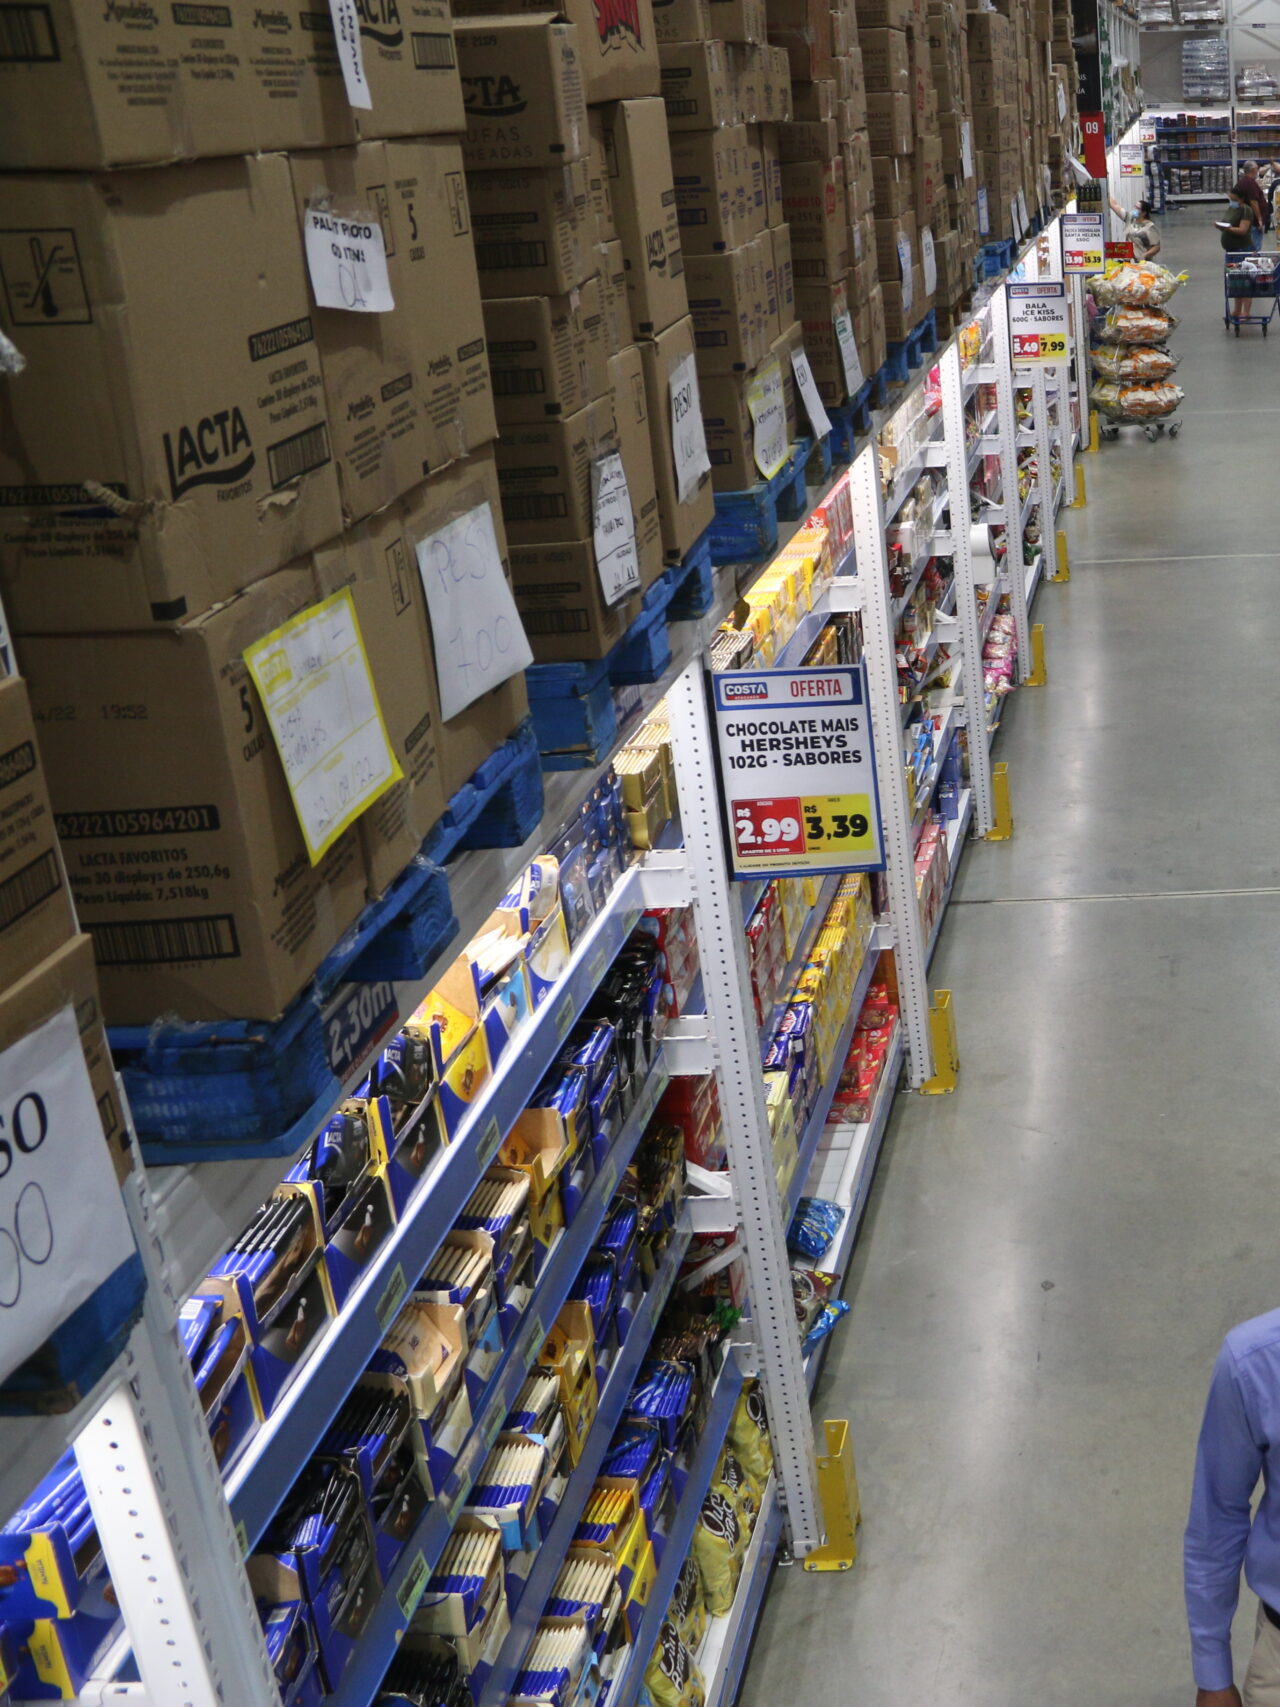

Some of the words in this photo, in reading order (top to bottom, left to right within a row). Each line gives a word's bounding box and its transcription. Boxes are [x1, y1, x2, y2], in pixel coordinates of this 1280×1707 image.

[460, 75, 521, 106] CTA
[466, 126, 520, 144] UFAS
[1085, 122, 1099, 134] 09
[1040, 341, 1065, 352] 7,99
[162, 406, 253, 503] LACTA
[726, 683, 767, 695] COSTA
[790, 678, 842, 698] OFERTA
[101, 704, 149, 720] 19:52
[725, 719, 817, 737] CHOCOLATE
[821, 718, 859, 733] MAIS
[740, 734, 848, 752] HERSHEYS
[728, 754, 768, 769] 102G
[782, 749, 862, 767] SABORES
[804, 805, 817, 814] R$
[57, 809, 212, 836] 6222105964201
[735, 816, 800, 845] 2,99
[806, 813, 869, 840] 3,39
[79, 852, 115, 867] LACTA
[121, 848, 189, 866] FAVORITOS
[324, 1130, 343, 1147] LACTA
